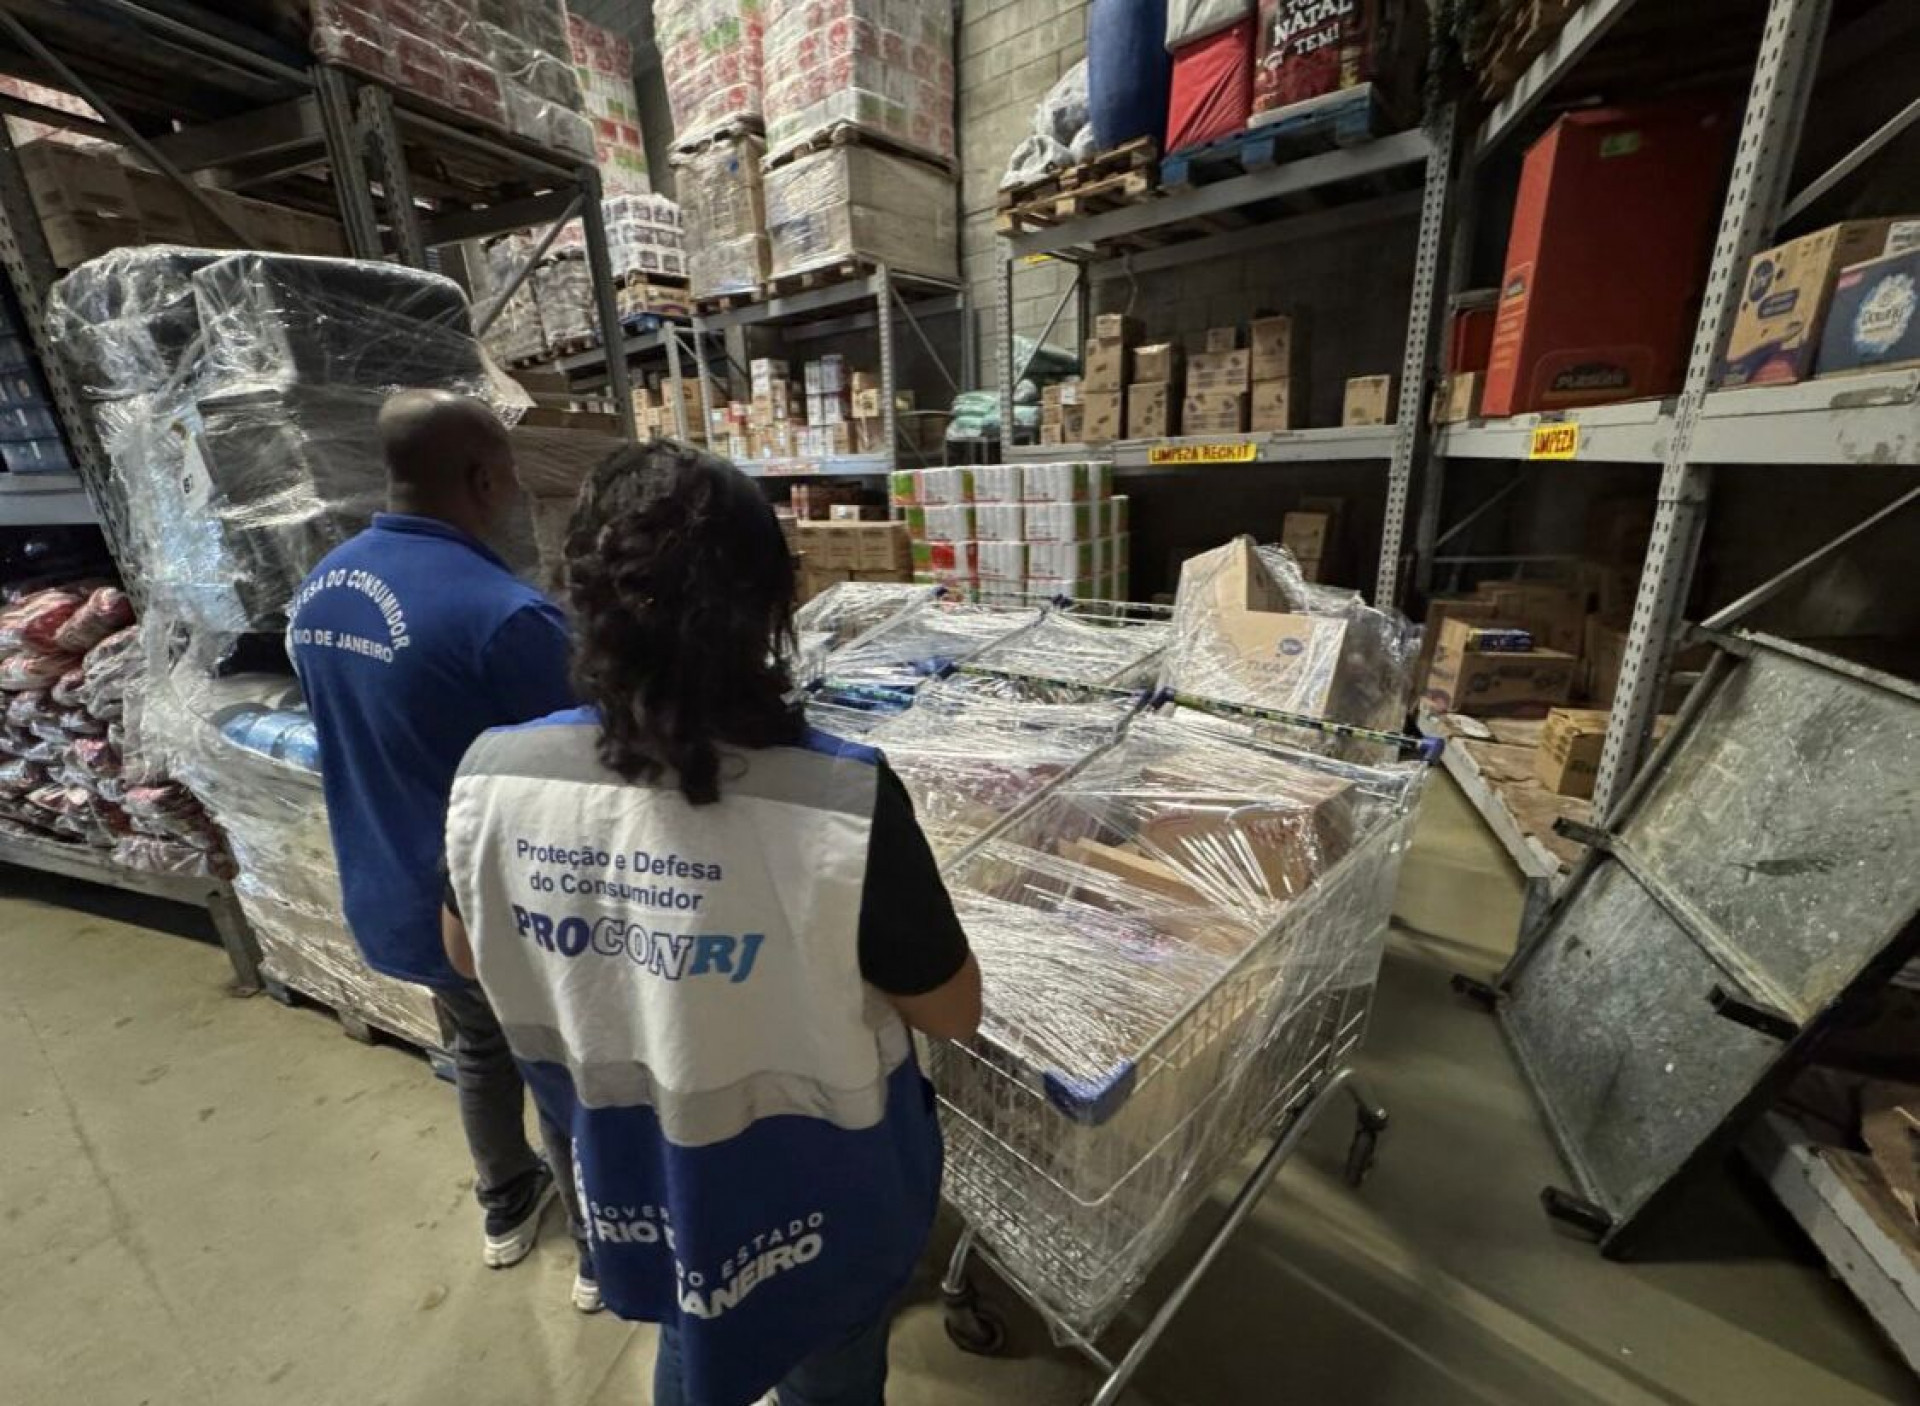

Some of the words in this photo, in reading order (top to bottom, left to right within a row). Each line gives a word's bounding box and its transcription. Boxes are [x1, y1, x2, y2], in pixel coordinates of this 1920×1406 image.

[1274, 0, 1353, 46] NATAL
[1294, 22, 1339, 54] TEM!
[1151, 445, 1198, 462] LIMPEZA
[1534, 428, 1575, 454] LIMPEZA
[326, 569, 346, 588] DO
[346, 569, 411, 650] CONSUMIDOR
[314, 629, 333, 647] DE
[336, 632, 394, 663] JANEIRO
[516, 838, 610, 870] Proteção
[615, 852, 627, 869] e
[634, 851, 723, 881] Defesa
[530, 871, 554, 892] do
[560, 873, 703, 911] Consumidor
[595, 1218, 659, 1244] RIO
[722, 1212, 824, 1279] ESTADO
